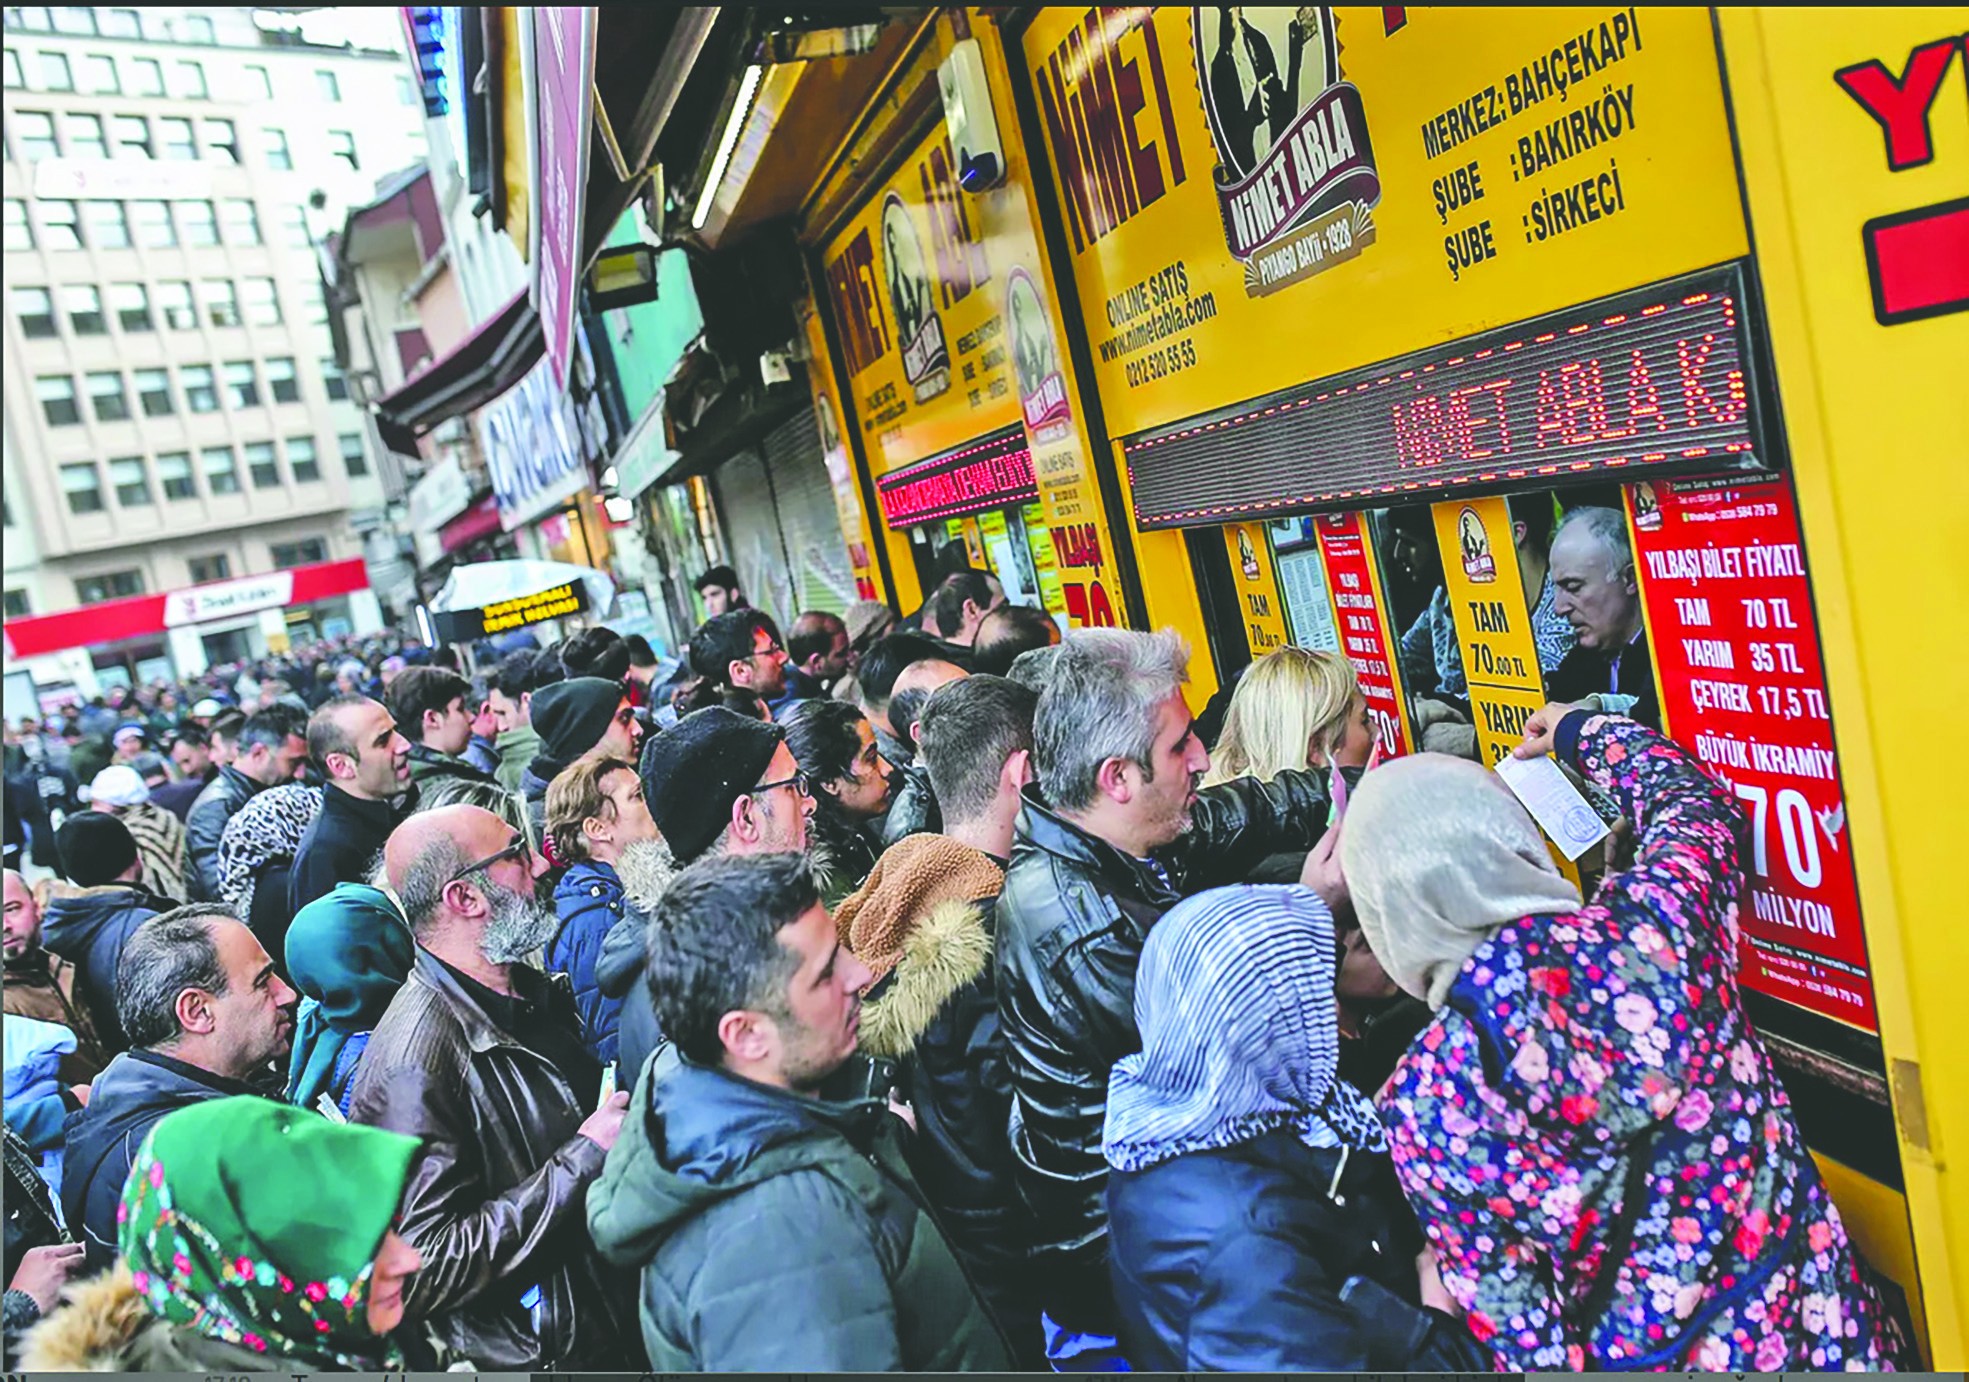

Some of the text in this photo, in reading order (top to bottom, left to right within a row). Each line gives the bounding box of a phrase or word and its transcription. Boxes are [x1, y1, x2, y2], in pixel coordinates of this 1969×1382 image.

[1504, 7, 1642, 116] BAHÇEKAPI
[1833, 32, 1969, 172] Y
[1289, 97, 1356, 196] ABLA
[1432, 160, 1485, 225] ŞUBE
[1326, 218, 1352, 255] 1928
[1444, 219, 1497, 282] ŞUBE
[1106, 260, 1189, 328] ONLINE SATIŞ
[1098, 291, 1217, 363] www.nimetabla.com
[1125, 338, 1196, 388] 0212 520 55 55
[1050, 522, 1104, 578] YILBAŞI
[1645, 538, 1806, 587] YILBAŞI BİLET FİYATL
[1247, 594, 1271, 617] TAM
[1469, 602, 1510, 633] TAM
[1674, 598, 1798, 629] TAM 70 TL
[1470, 643, 1527, 677] 70.00 TL
[1682, 638, 1804, 674] YARIM 35 TL
[1690, 678, 1829, 721] ÇEYREK 17,5 TL
[1694, 729, 1835, 781] BÜYÜK İKRAMİY
[1734, 783, 1823, 889] 70
[1752, 886, 1837, 939] MİLYON
